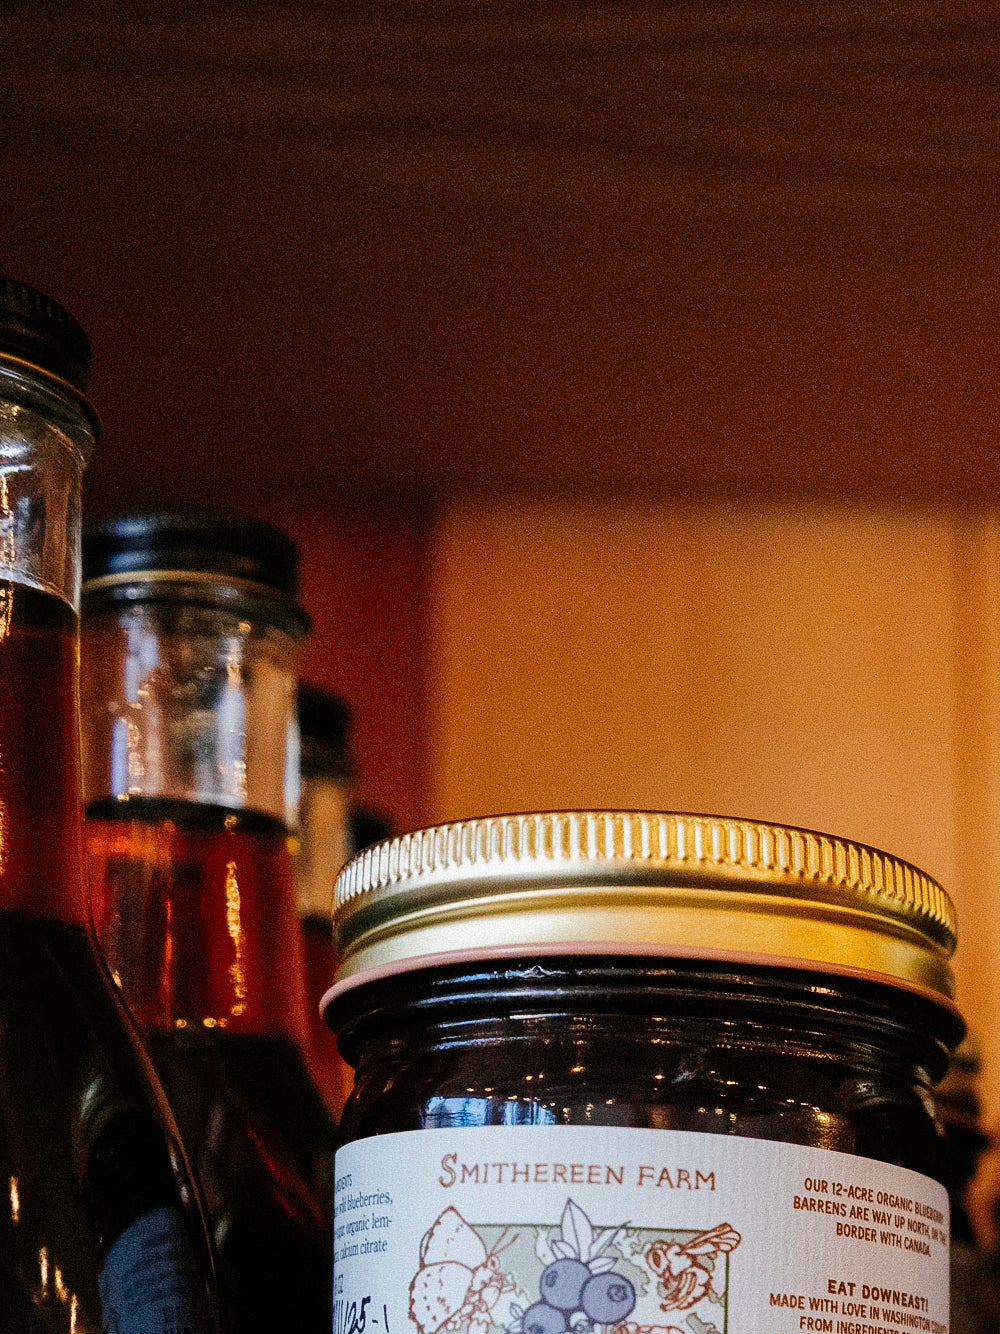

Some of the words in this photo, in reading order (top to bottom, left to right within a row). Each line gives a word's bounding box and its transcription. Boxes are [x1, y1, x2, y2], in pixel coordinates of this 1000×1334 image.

[438, 1152, 624, 1188] SMITHEREEN
[637, 1166, 716, 1191] FARM
[827, 1279, 856, 1297] EAT
[861, 1284, 929, 1312] DOWNEAST!
